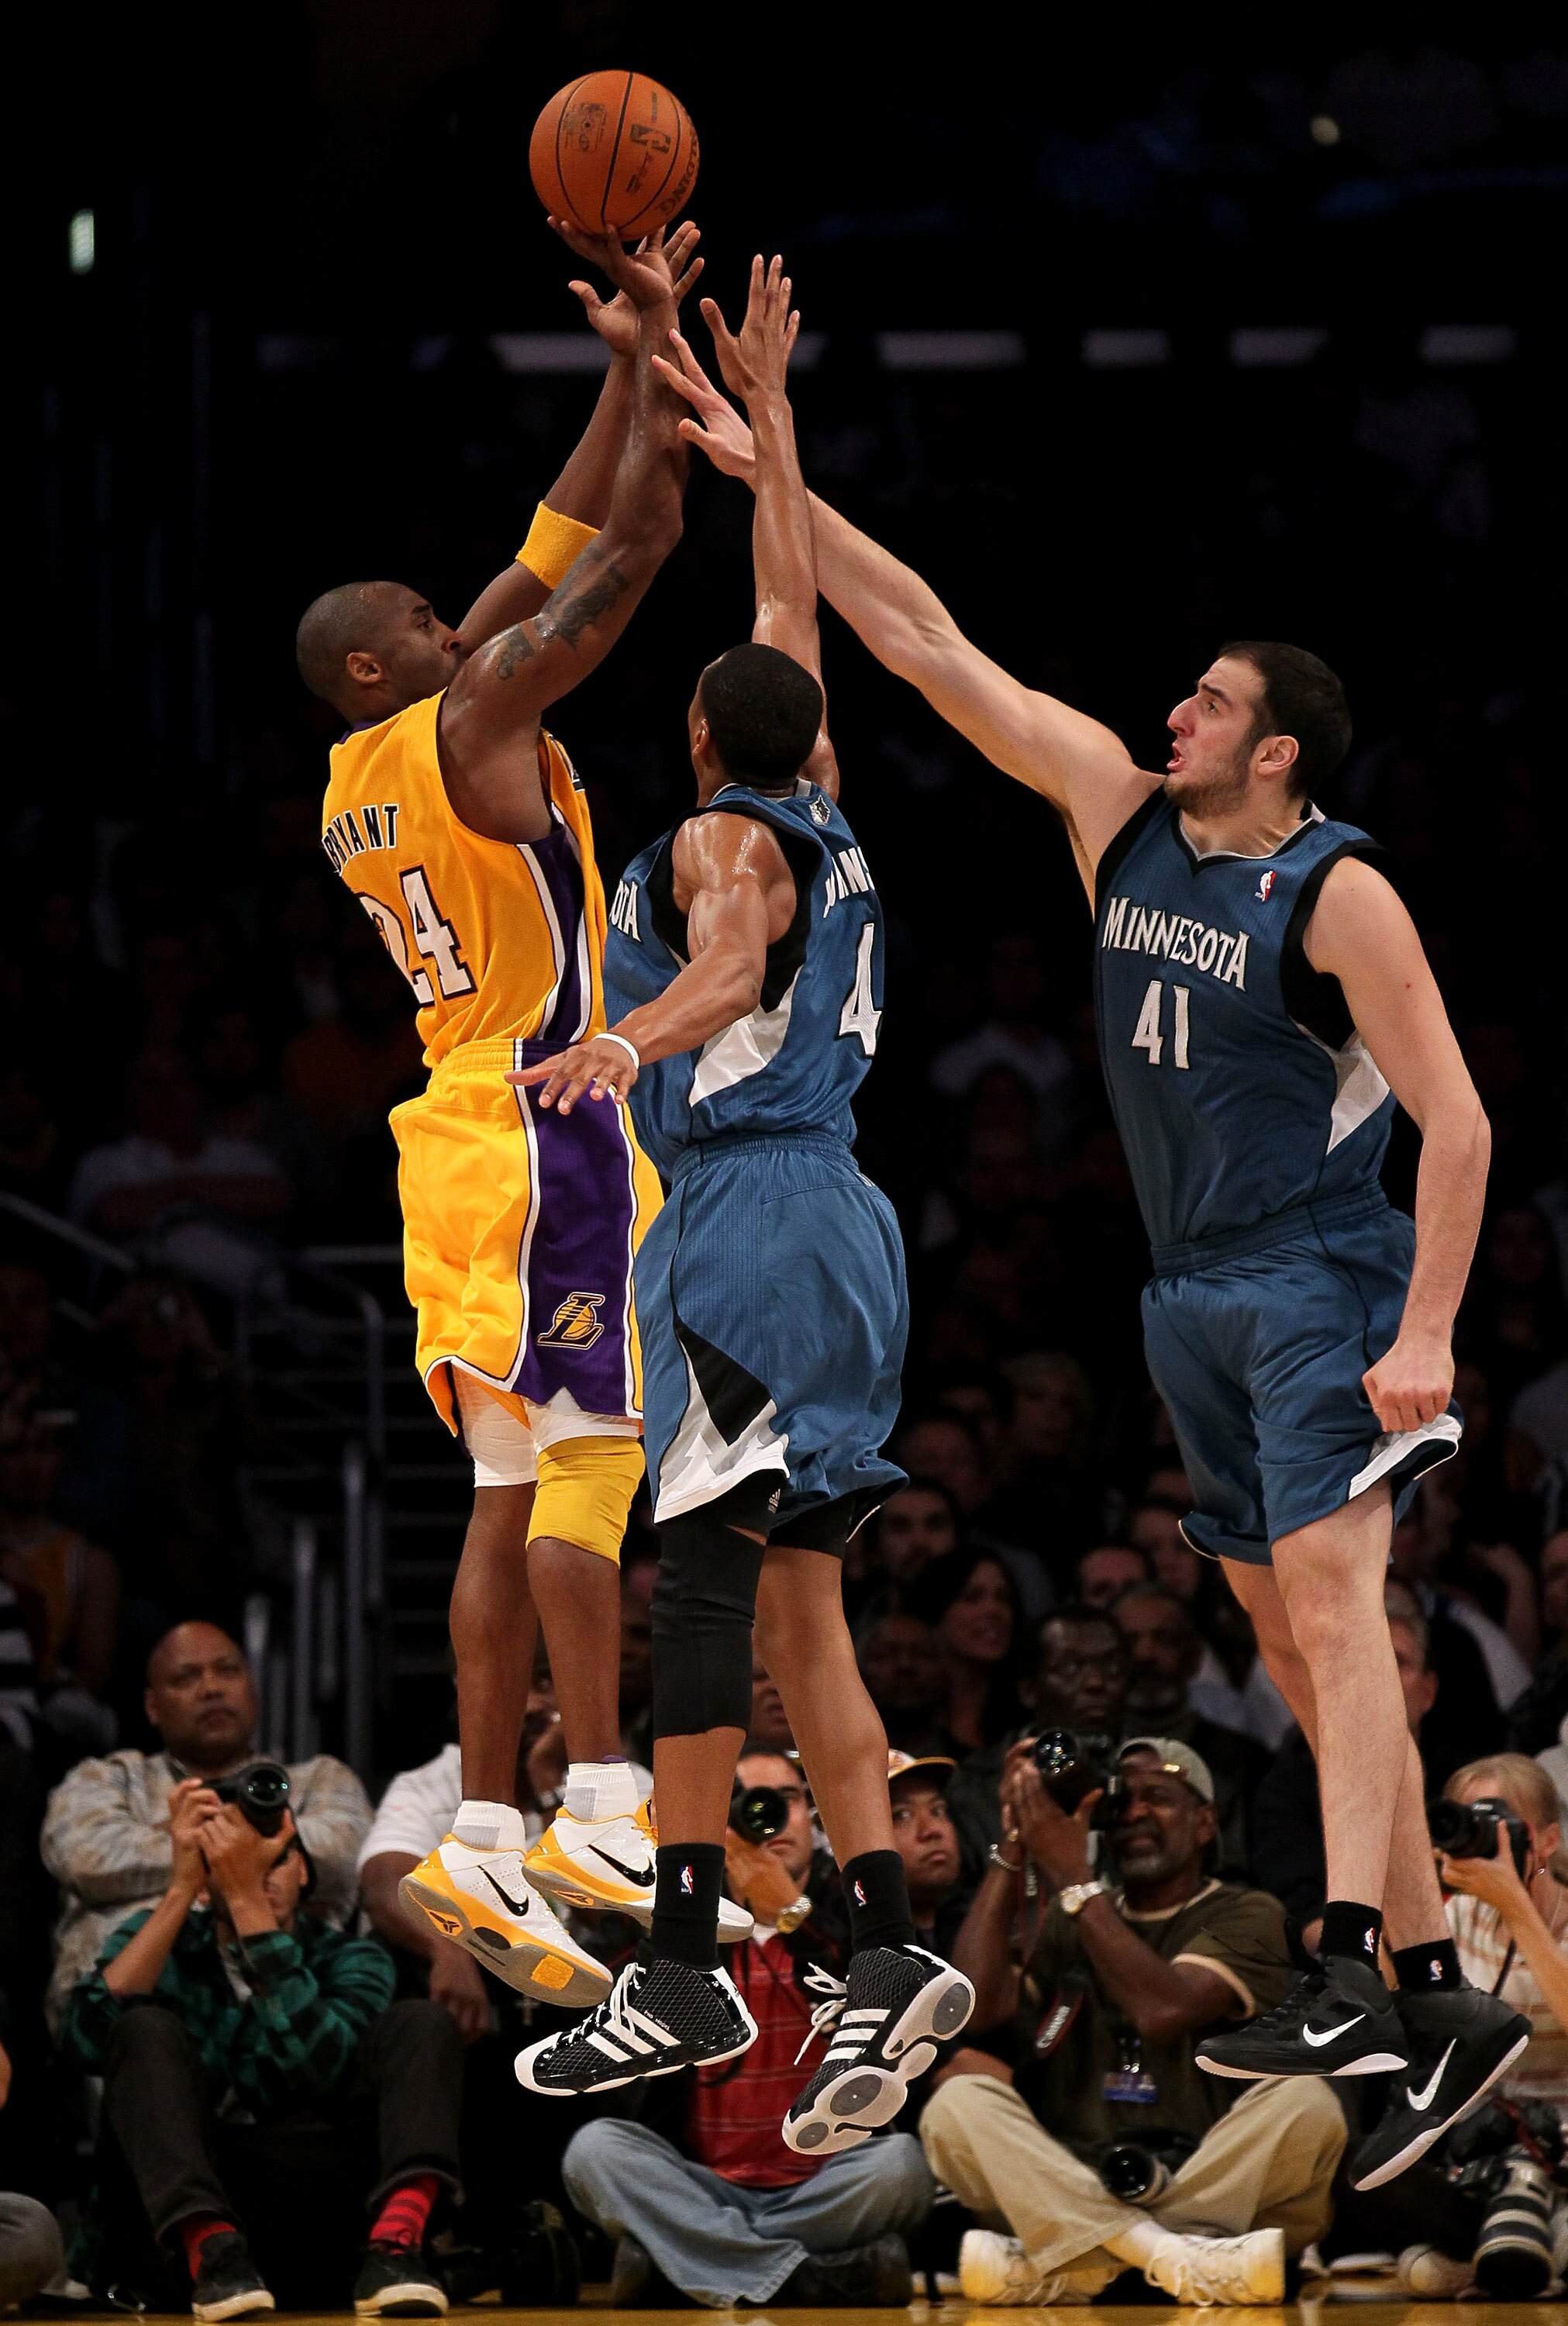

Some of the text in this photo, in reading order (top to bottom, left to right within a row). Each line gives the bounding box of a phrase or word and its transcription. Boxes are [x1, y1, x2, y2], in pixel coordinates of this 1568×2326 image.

[322, 803, 399, 876] BRYANT
[354, 864, 477, 1007] 24
[1101, 896, 1250, 992] MINNESOTA
[839, 922, 882, 1056] 4
[1132, 979, 1190, 1070] 41
